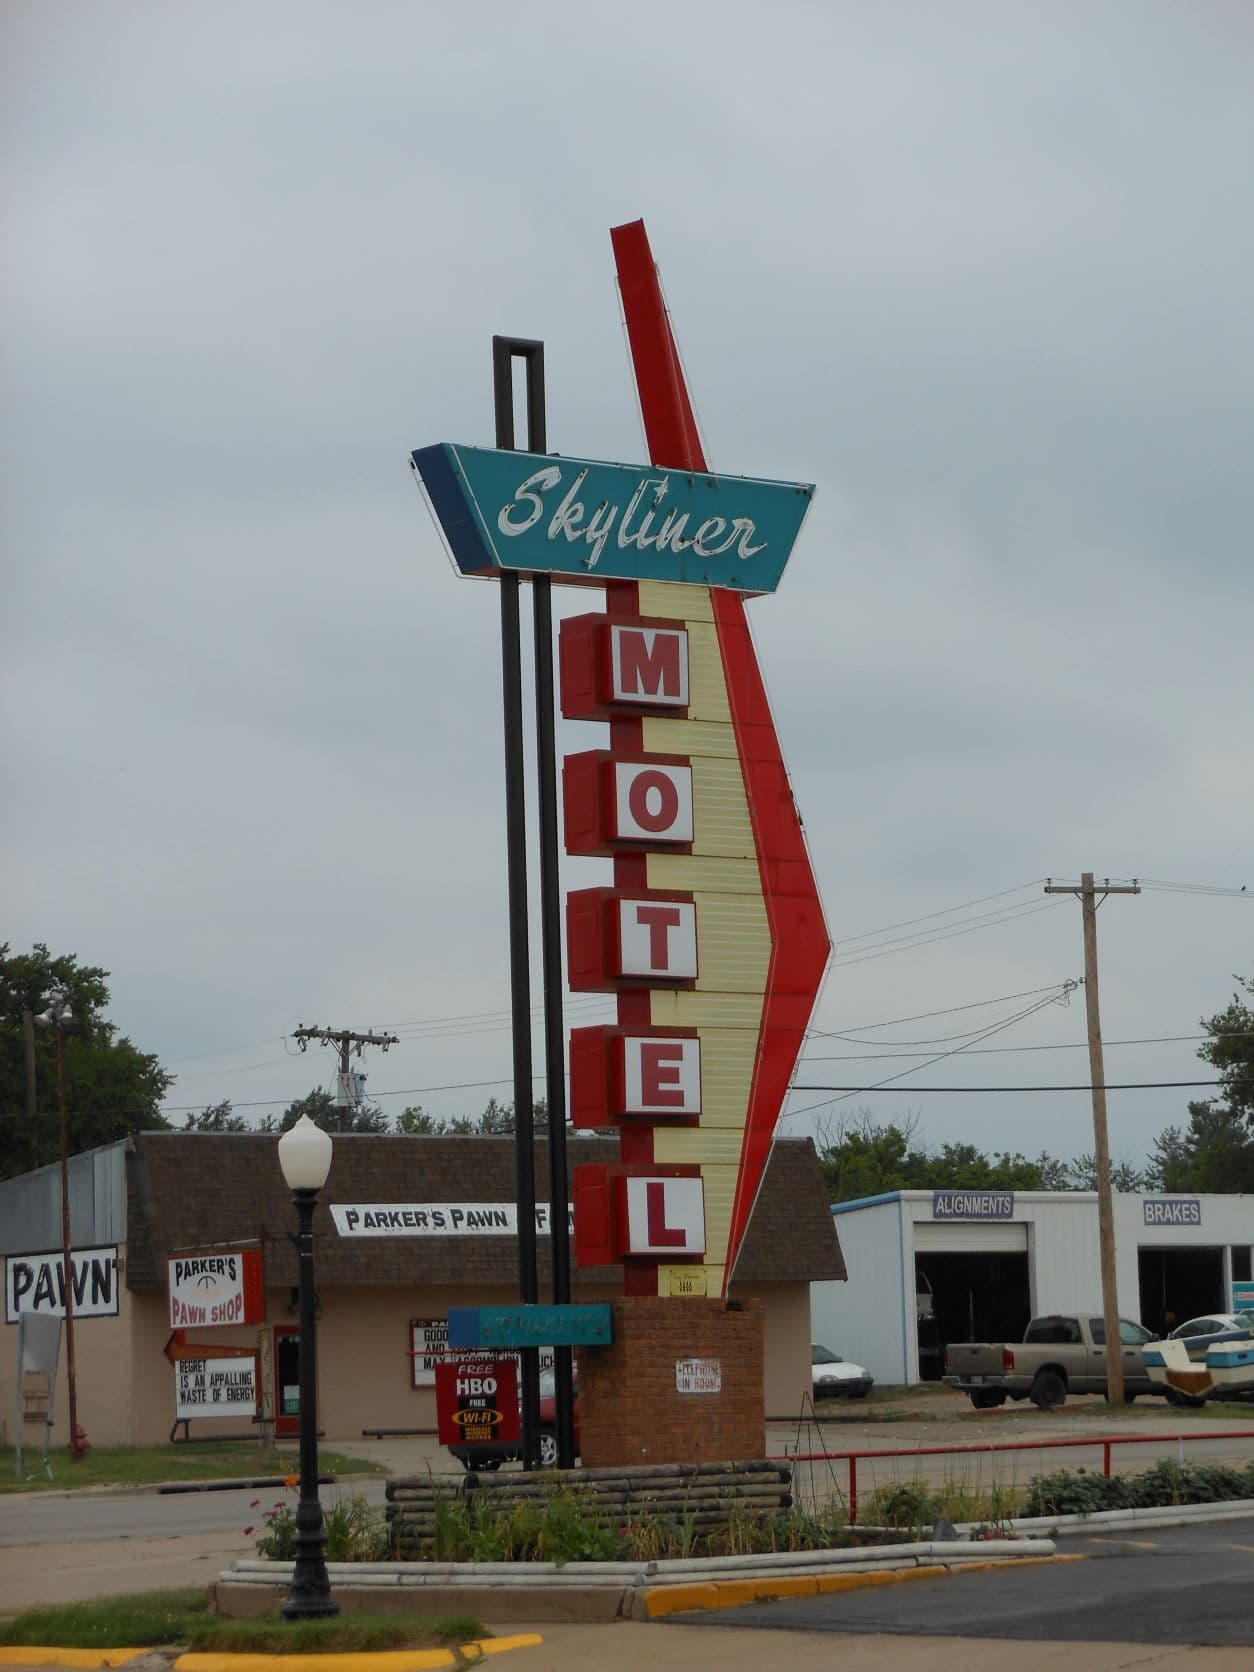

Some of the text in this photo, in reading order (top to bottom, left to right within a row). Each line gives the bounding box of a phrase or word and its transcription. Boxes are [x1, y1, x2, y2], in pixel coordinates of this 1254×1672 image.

[497, 466, 768, 570] Skyliner
[619, 630, 686, 1247] MOTEL
[936, 1196, 1012, 1214] ALIGNMENTS
[1145, 1203, 1199, 1222] BRAKES
[345, 1208, 508, 1230] PARKER'S PAWN
[175, 1256, 237, 1287] PARKER'S
[13, 1257, 111, 1312] PAWN
[172, 1292, 242, 1324] PAWN SHOP
[179, 1359, 207, 1373] REGRET
[458, 1364, 495, 1375] FREE
[180, 1371, 252, 1388] IS AN APPALLING
[456, 1377, 497, 1396] HBO
[179, 1386, 255, 1403] WASTE OF ENERGY
[469, 1399, 486, 1407] FREE
